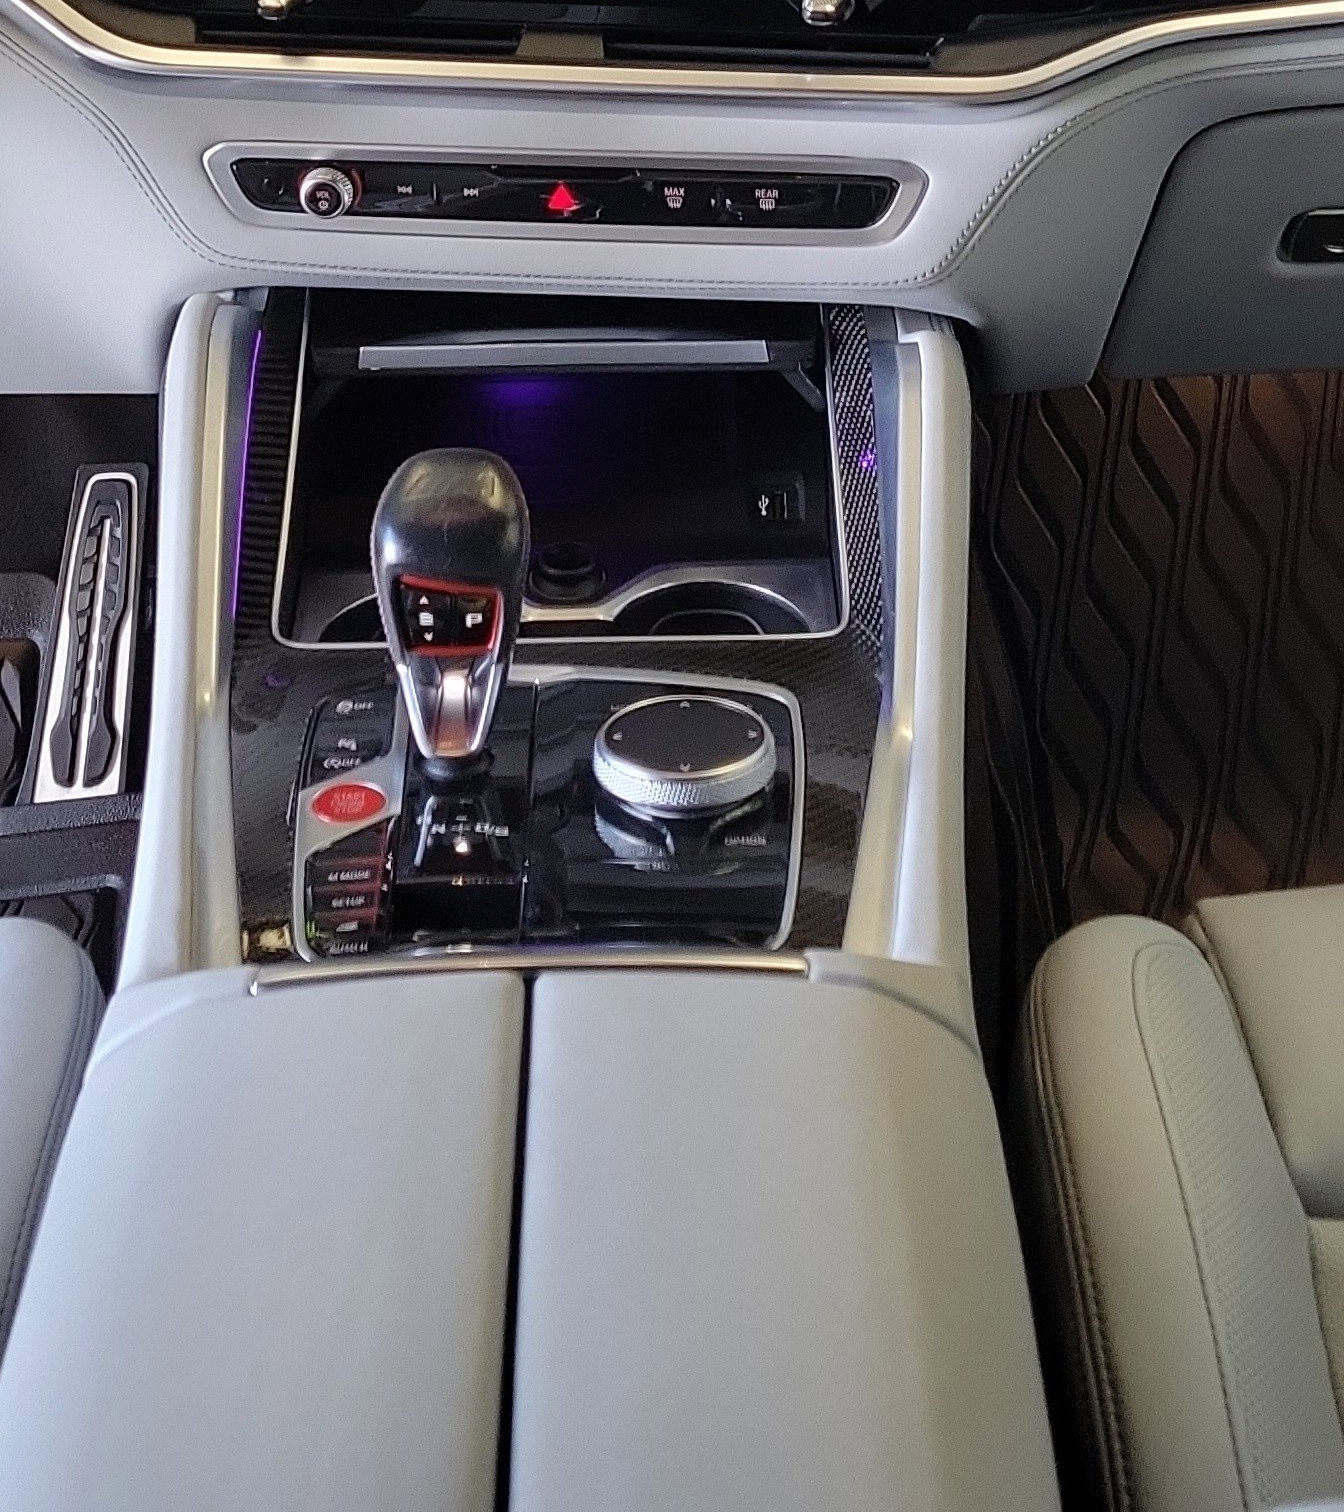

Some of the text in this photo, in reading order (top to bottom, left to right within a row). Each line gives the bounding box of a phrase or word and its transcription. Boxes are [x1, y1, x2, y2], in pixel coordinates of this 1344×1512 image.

[664, 186, 685, 197] MAX
[755, 188, 779, 200] REAR
[465, 612, 483, 628] P
